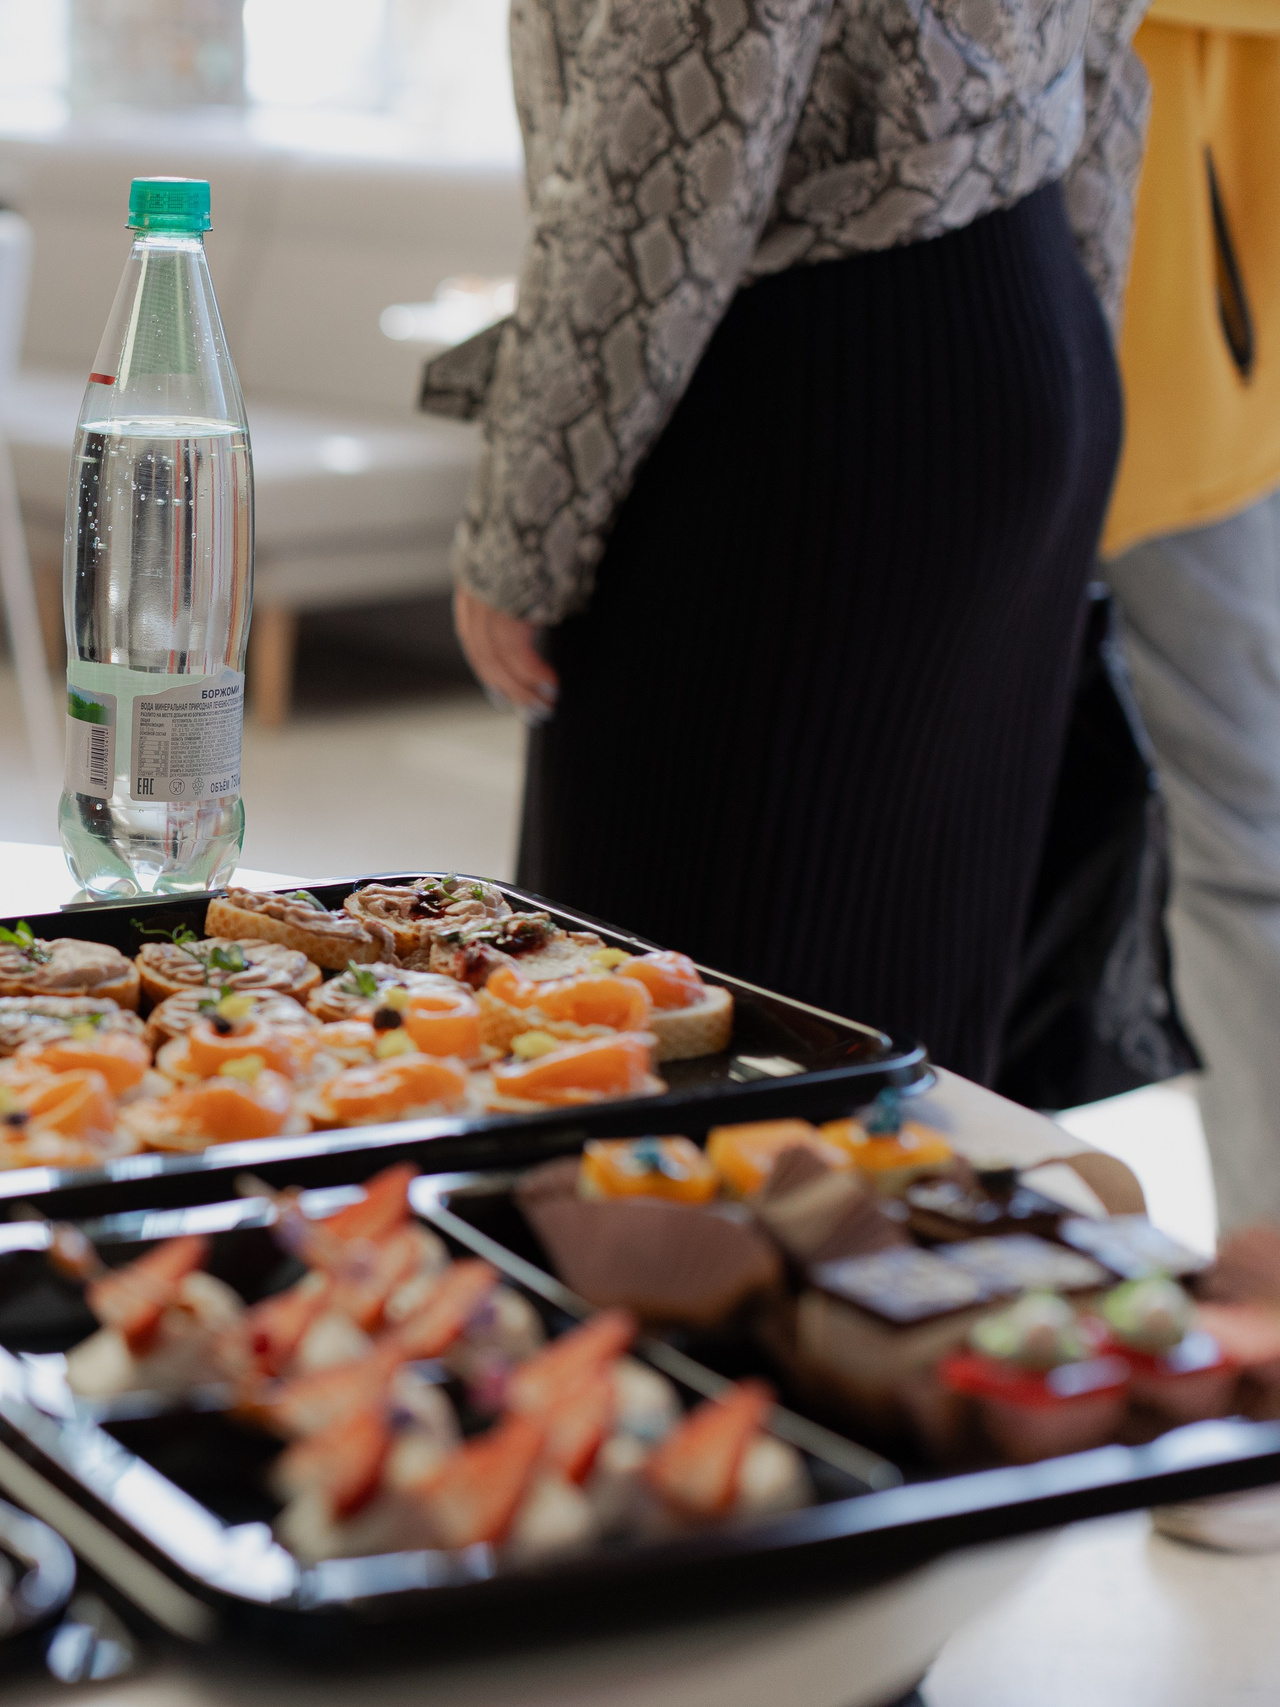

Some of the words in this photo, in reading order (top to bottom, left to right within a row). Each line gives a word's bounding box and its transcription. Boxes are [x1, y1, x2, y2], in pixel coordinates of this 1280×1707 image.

[202, 685, 240, 699] БОРЖОМИ
[140, 702, 153, 711] ВОДА
[154, 703, 188, 711] МИНЕРАЛЬНАЯ
[189, 703, 213, 711] ПРИРОДНАЯ
